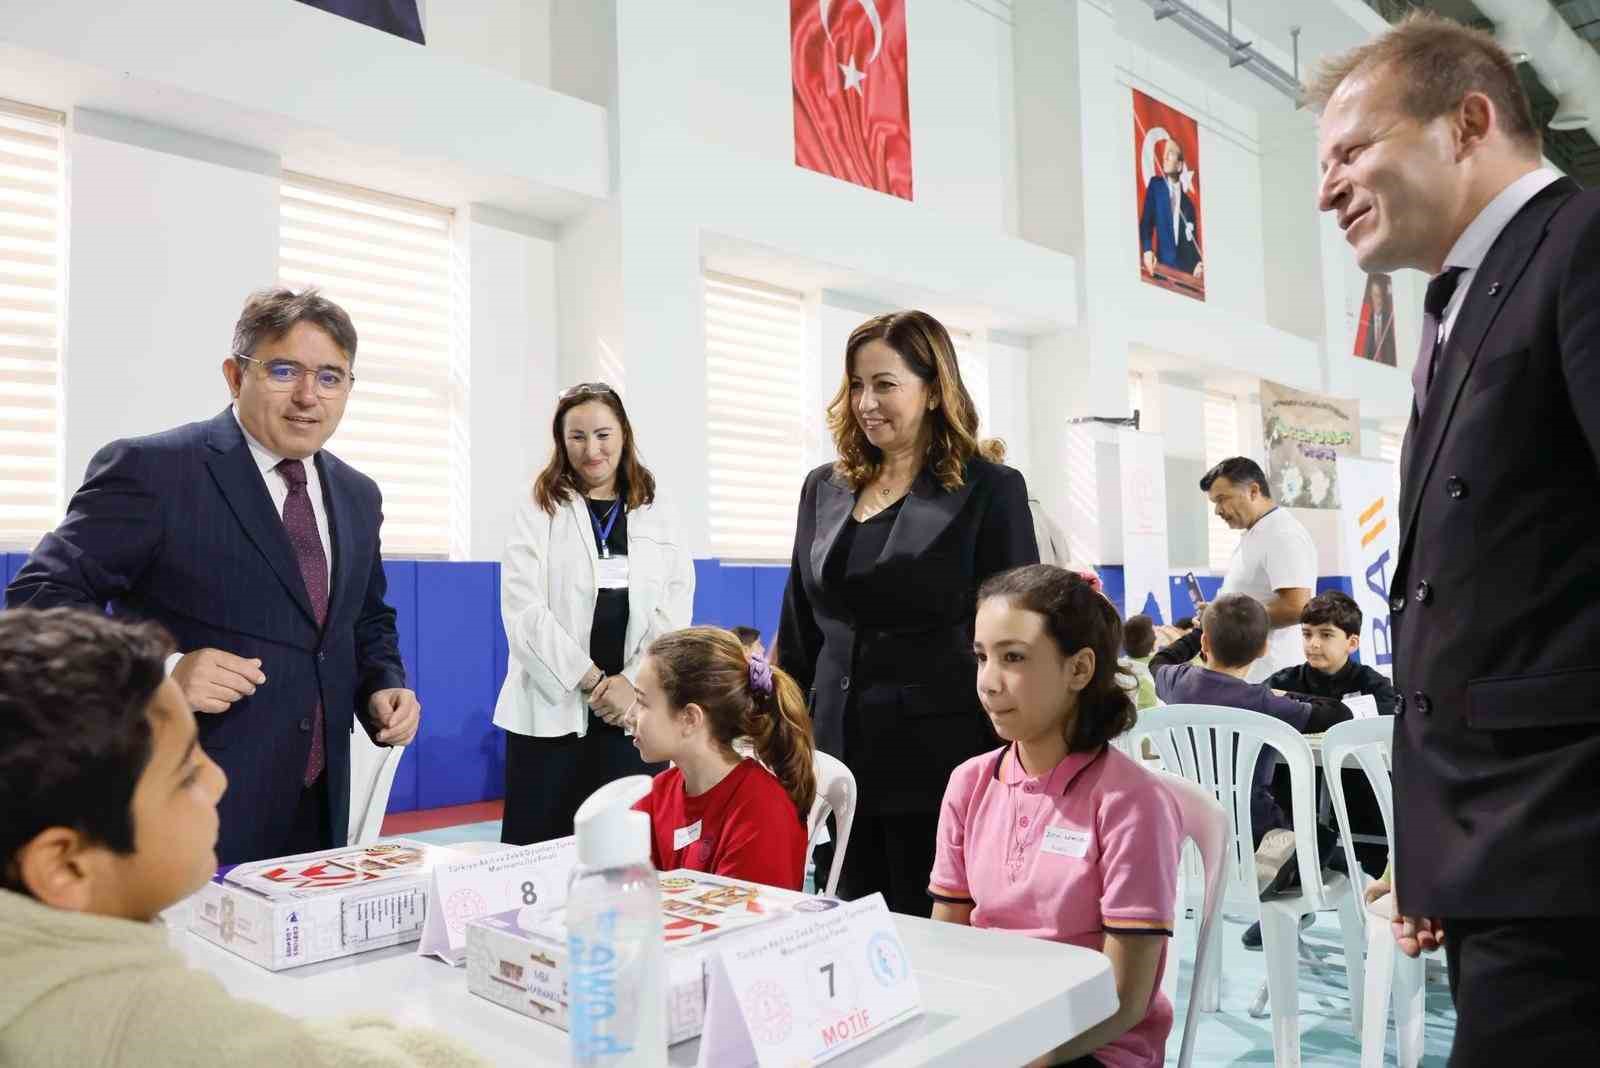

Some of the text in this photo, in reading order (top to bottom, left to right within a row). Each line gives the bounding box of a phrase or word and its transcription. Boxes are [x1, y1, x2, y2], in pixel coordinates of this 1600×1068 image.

[521, 881, 537, 905] 8
[820, 962, 837, 998] 7
[821, 1008, 870, 1048] MOTİF
